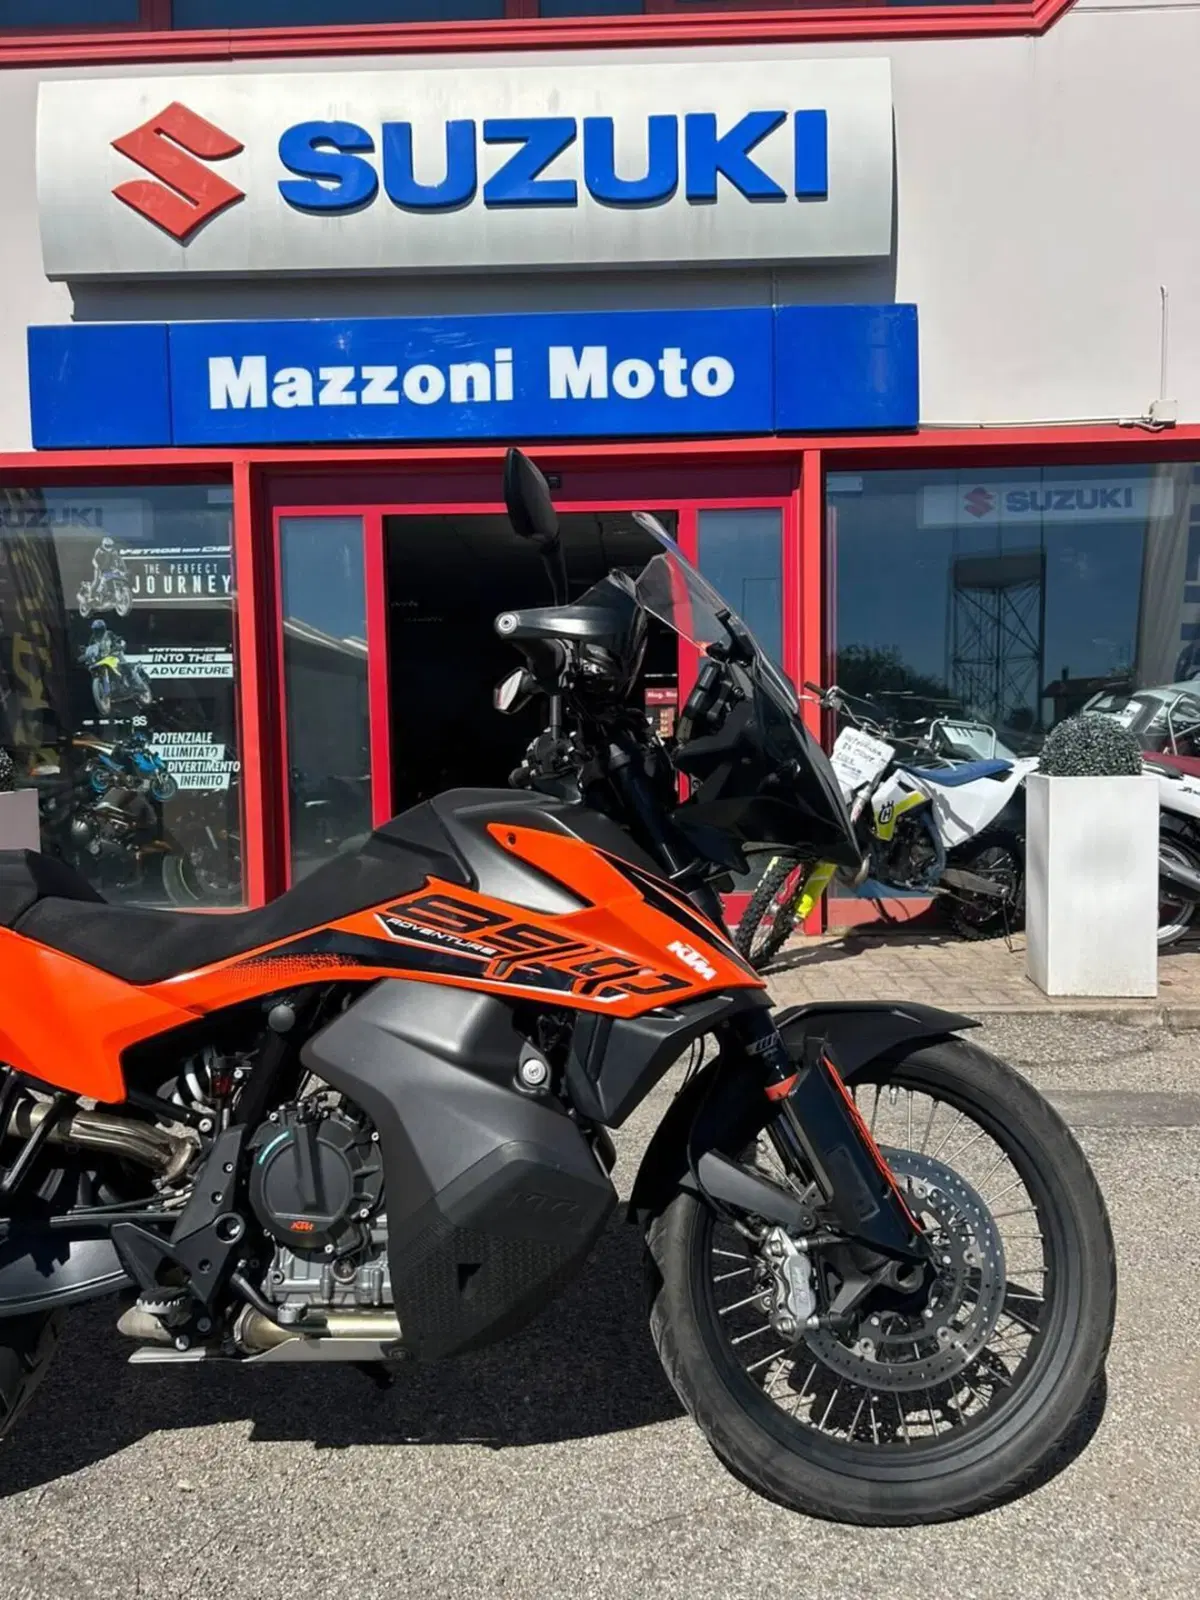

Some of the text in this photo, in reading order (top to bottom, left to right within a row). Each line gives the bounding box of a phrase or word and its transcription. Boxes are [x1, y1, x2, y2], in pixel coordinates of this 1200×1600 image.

[278, 108, 826, 212] SUZUKI
[208, 345, 735, 410] Mazzoni Moto
[1006, 487, 1133, 513] SUZUKI
[0, 507, 103, 528] UZUKI
[144, 563, 218, 574] THE PERFECT
[131, 575, 231, 594] JOURNEY
[153, 653, 214, 662] INTO THE
[150, 666, 230, 675] ADVENTURE
[152, 732, 213, 744] POTENZIALE
[162, 746, 219, 758] ILLIMITATO
[167, 761, 241, 773] DIVERTIMENTO
[179, 775, 223, 787] INFINITO
[386, 917, 498, 956] ADVENTURE
[666, 940, 717, 982] KTM
